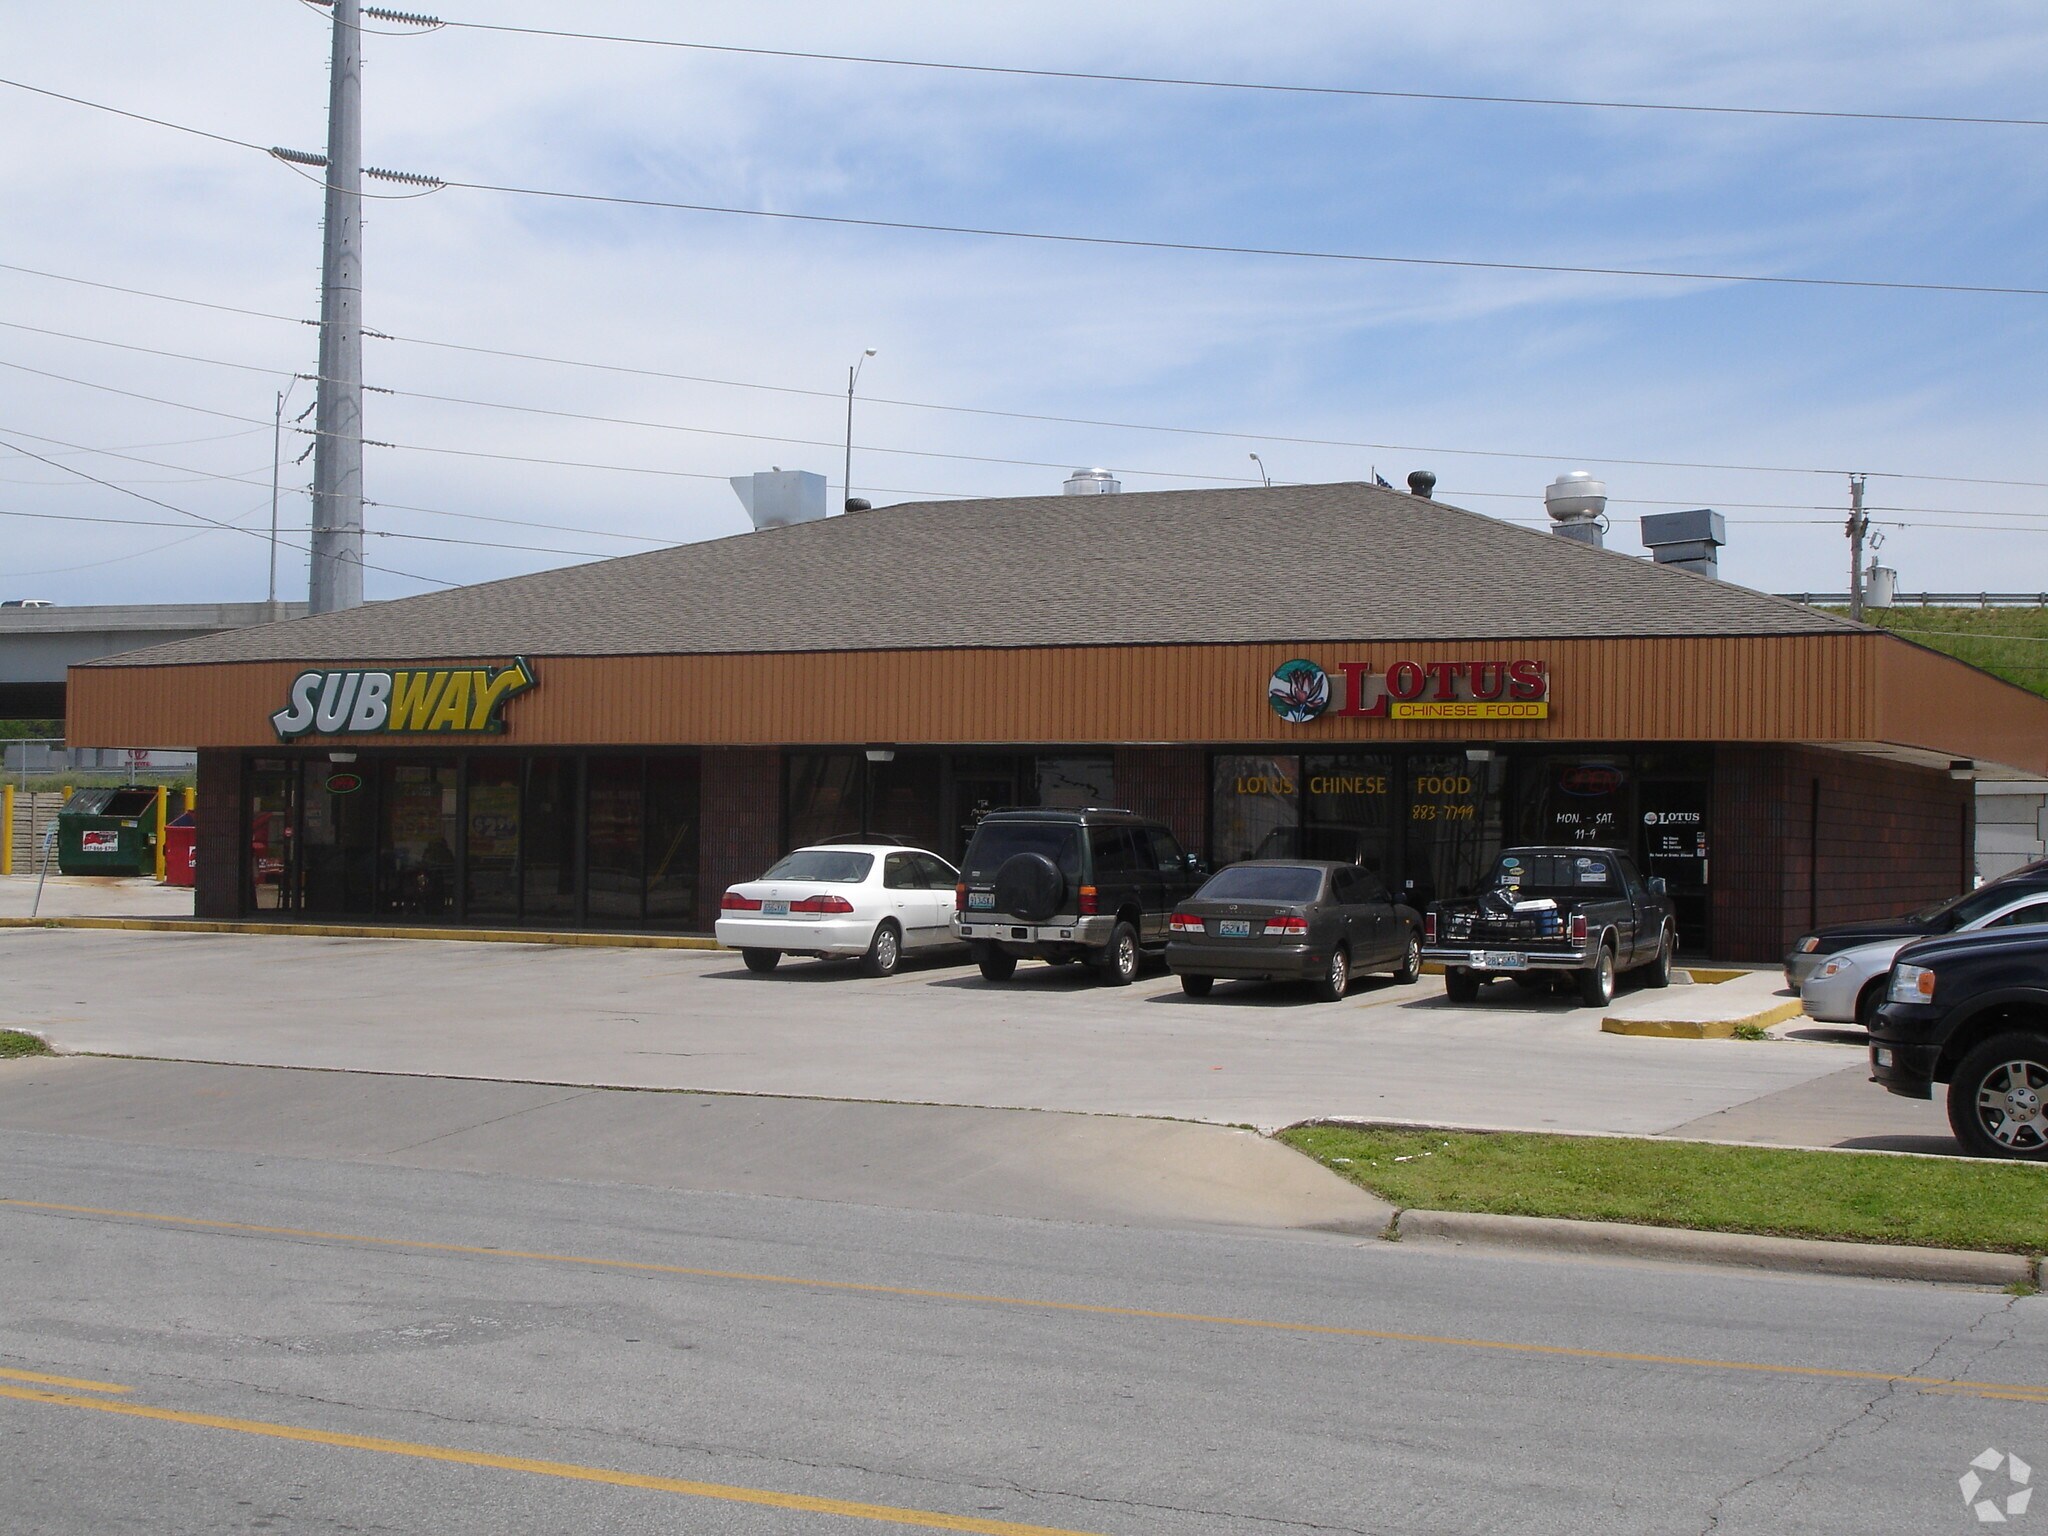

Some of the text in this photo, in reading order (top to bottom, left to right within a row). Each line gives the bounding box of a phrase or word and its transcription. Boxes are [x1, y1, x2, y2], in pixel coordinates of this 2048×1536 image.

[1337, 660, 1547, 718] LOTUS
[272, 664, 528, 737] SUBWAY
[1399, 704, 1540, 717] CHINESE FOOD
[1236, 777, 1471, 795] LOTUS CHINESE FOOD
[1412, 804, 1475, 821] 883-7799
[1658, 812, 1700, 825] LOTUS
